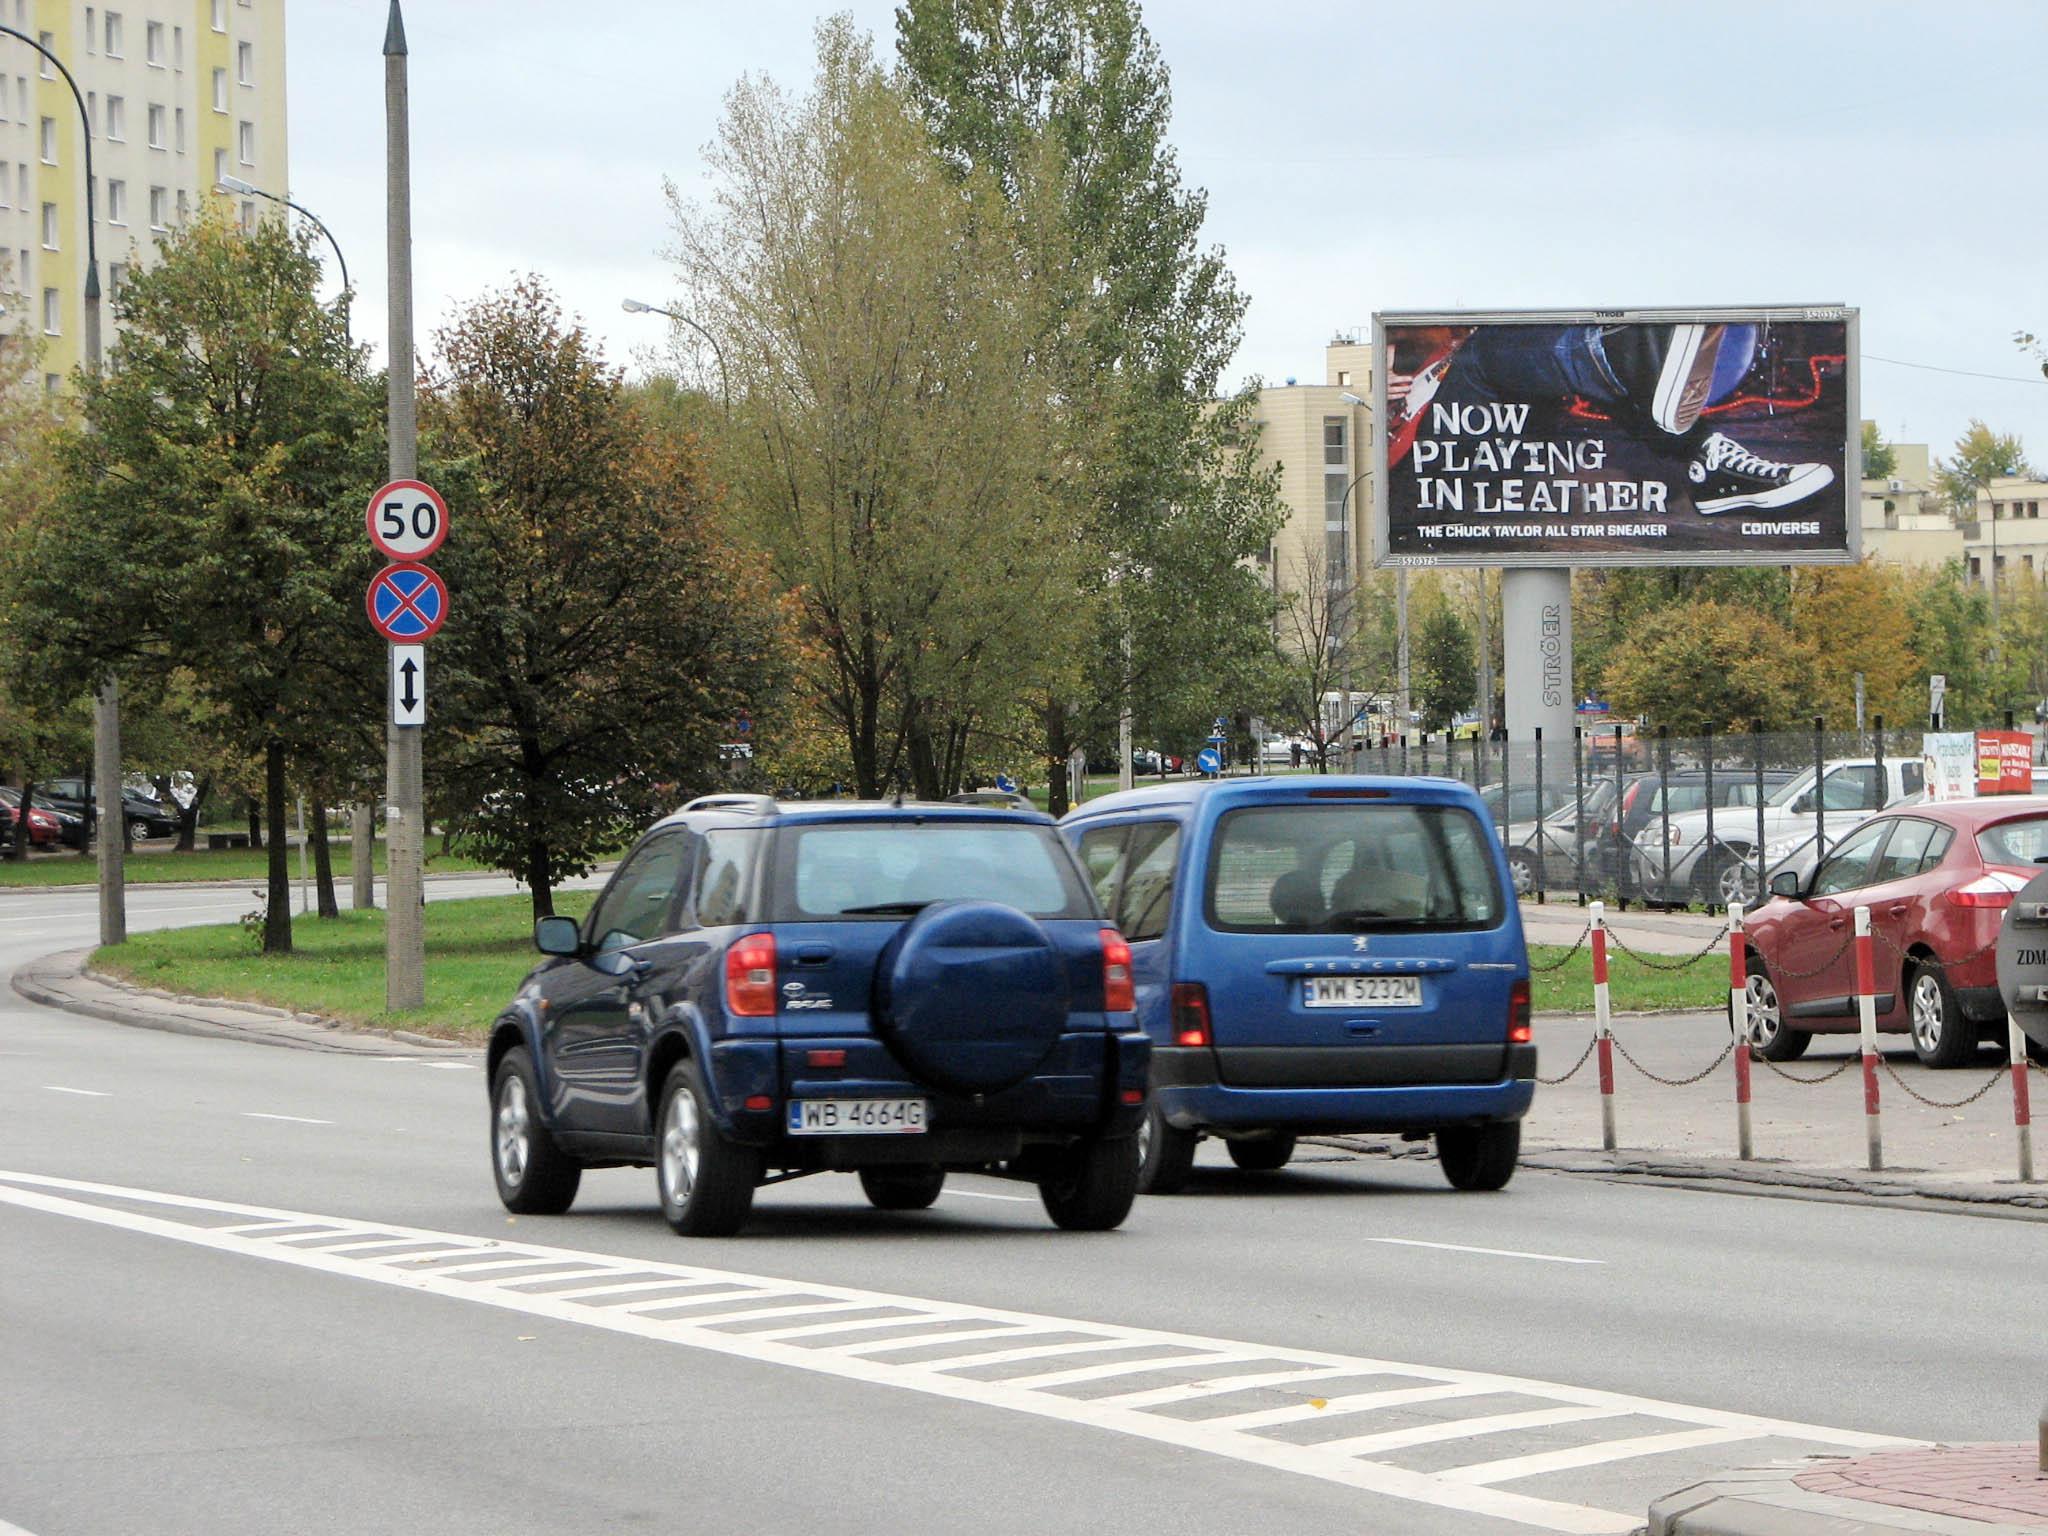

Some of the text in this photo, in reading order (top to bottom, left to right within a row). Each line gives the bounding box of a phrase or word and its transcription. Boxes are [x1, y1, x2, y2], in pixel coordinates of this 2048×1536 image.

[1432, 402, 1531, 435] NOW
[1413, 438, 1607, 475] PLAYING
[1416, 477, 1668, 513] IN LEATHER
[382, 502, 437, 540] 50
[1417, 524, 1667, 538] THE CHUCK TAYLOR ALL STAR SNEAKER
[1741, 521, 1820, 535] CONVERSE
[1540, 604, 1561, 707] STRÖER
[805, 1102, 921, 1127] WB 4664G
